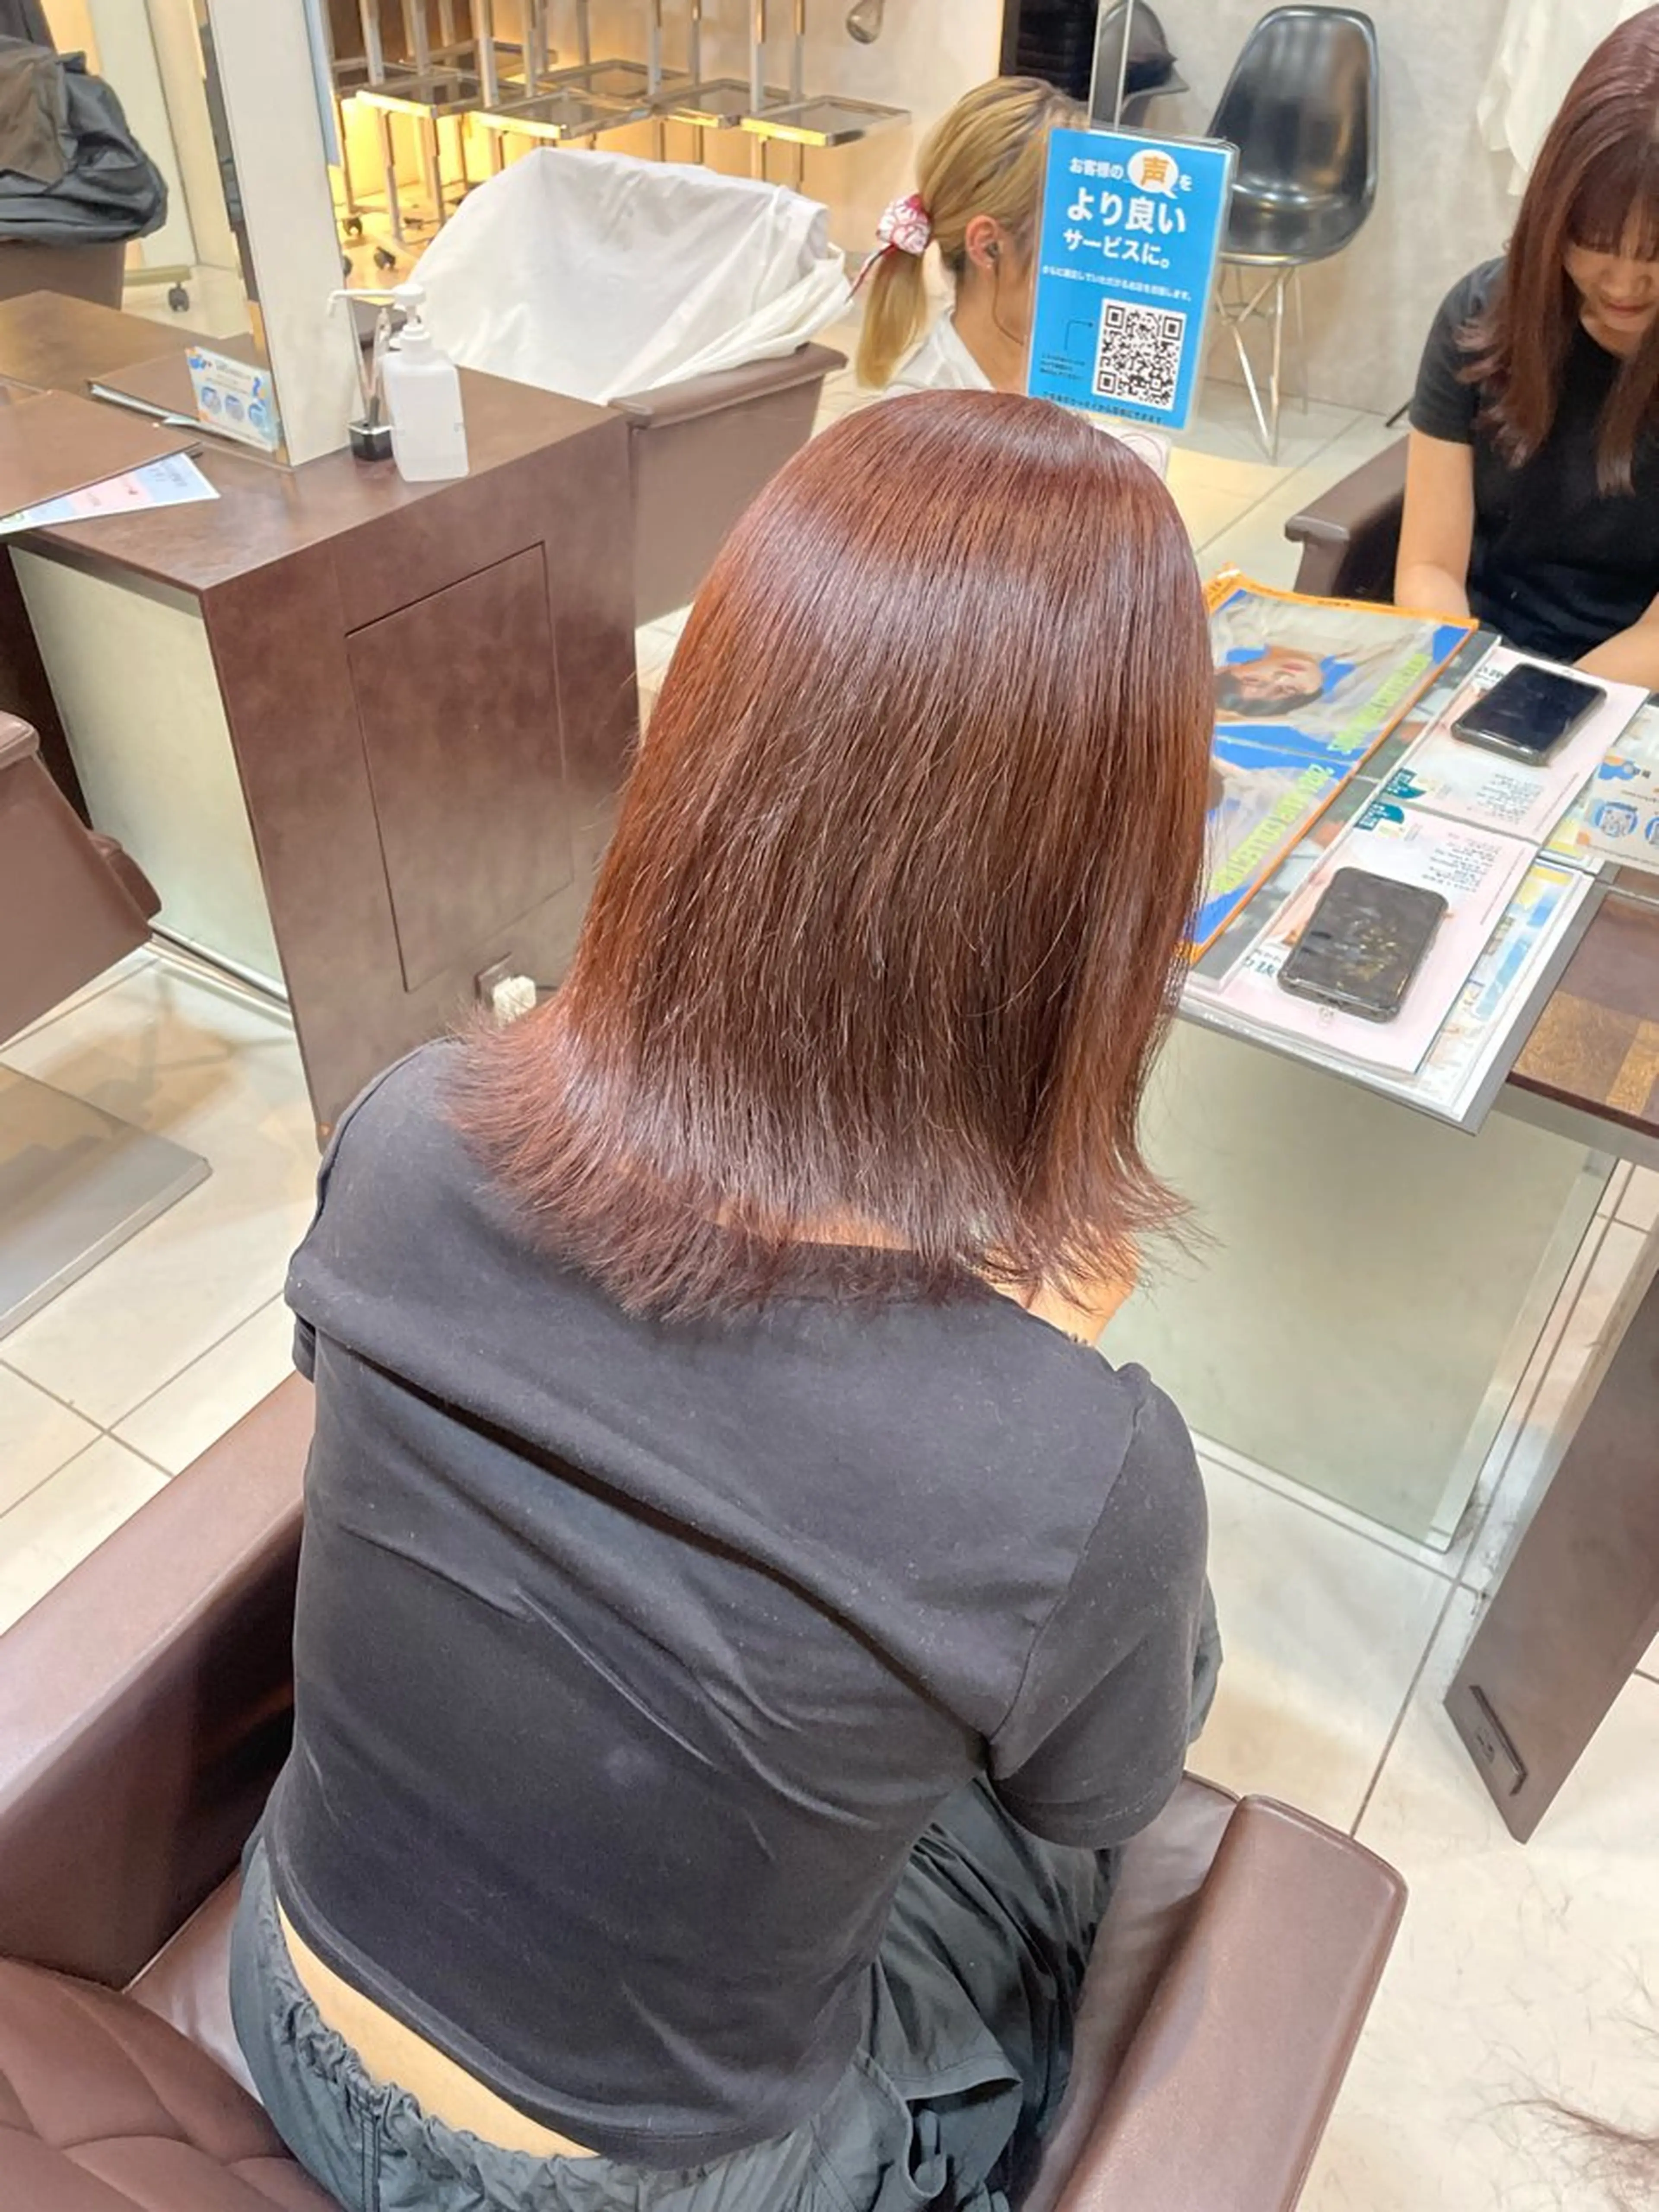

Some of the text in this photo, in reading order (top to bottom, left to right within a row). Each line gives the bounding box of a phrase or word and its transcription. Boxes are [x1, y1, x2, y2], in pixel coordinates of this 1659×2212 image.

[1067, 186, 1186, 235] より良い
[1062, 228, 1170, 269] サービスに。
